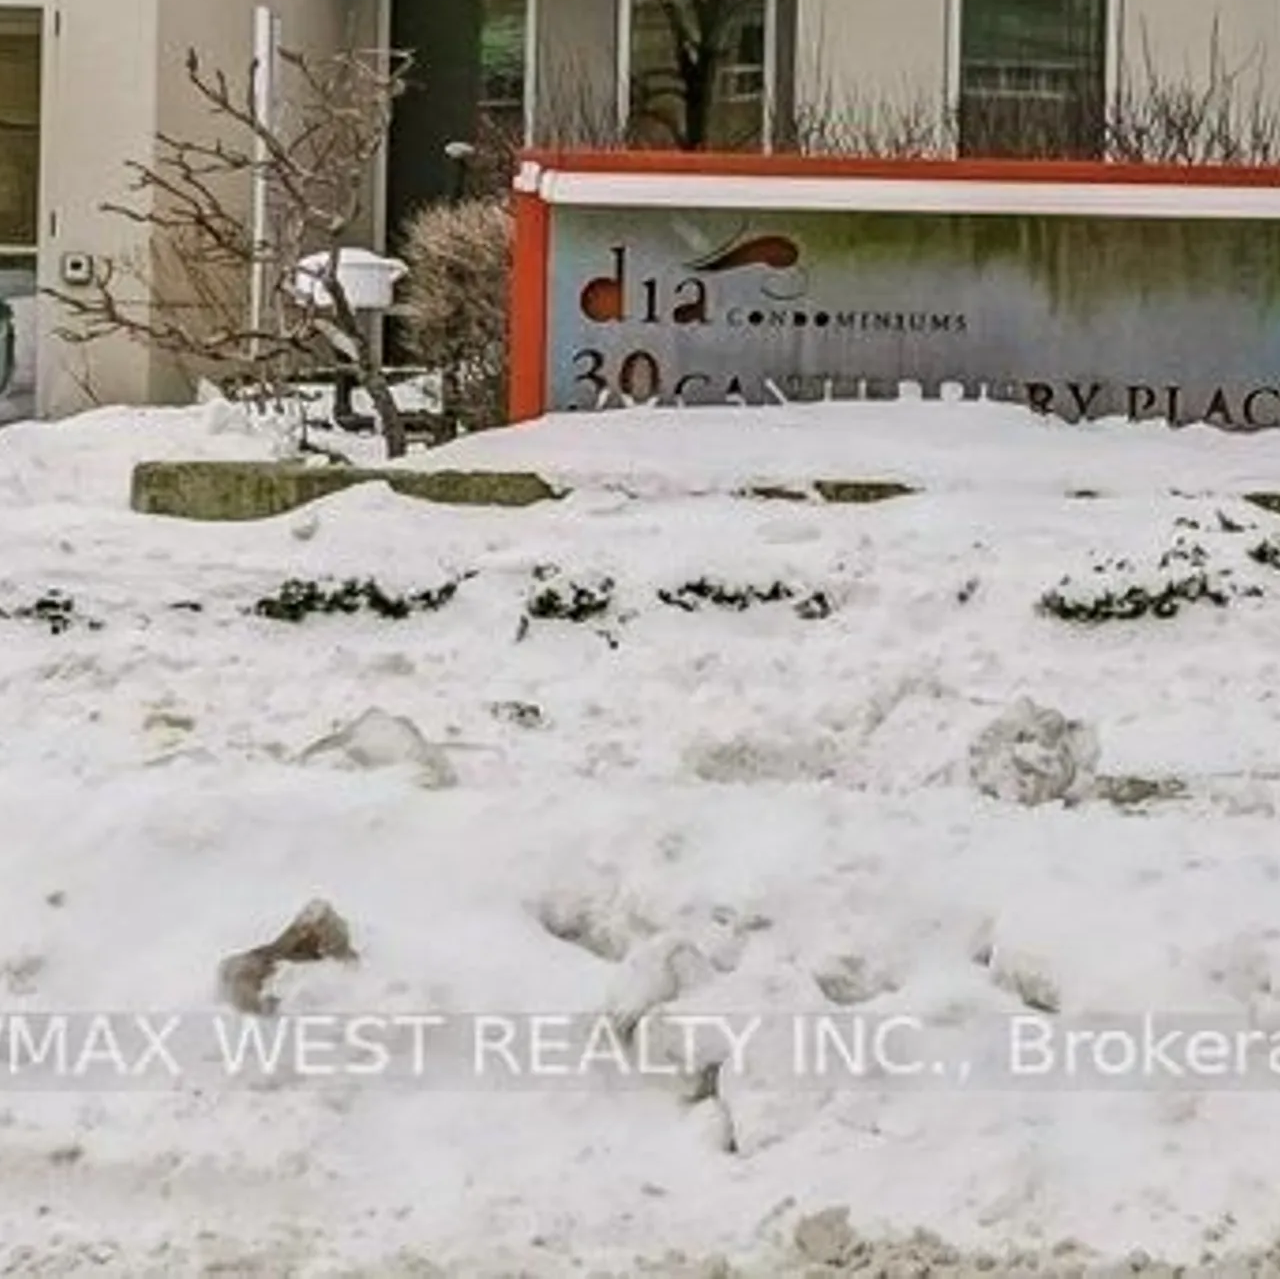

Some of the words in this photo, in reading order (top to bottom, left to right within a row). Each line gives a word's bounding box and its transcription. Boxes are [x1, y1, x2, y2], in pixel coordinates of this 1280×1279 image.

[579, 246, 709, 324] dia
[726, 307, 967, 332] CONDOMINIUMS
[568, 348, 662, 411] 30
